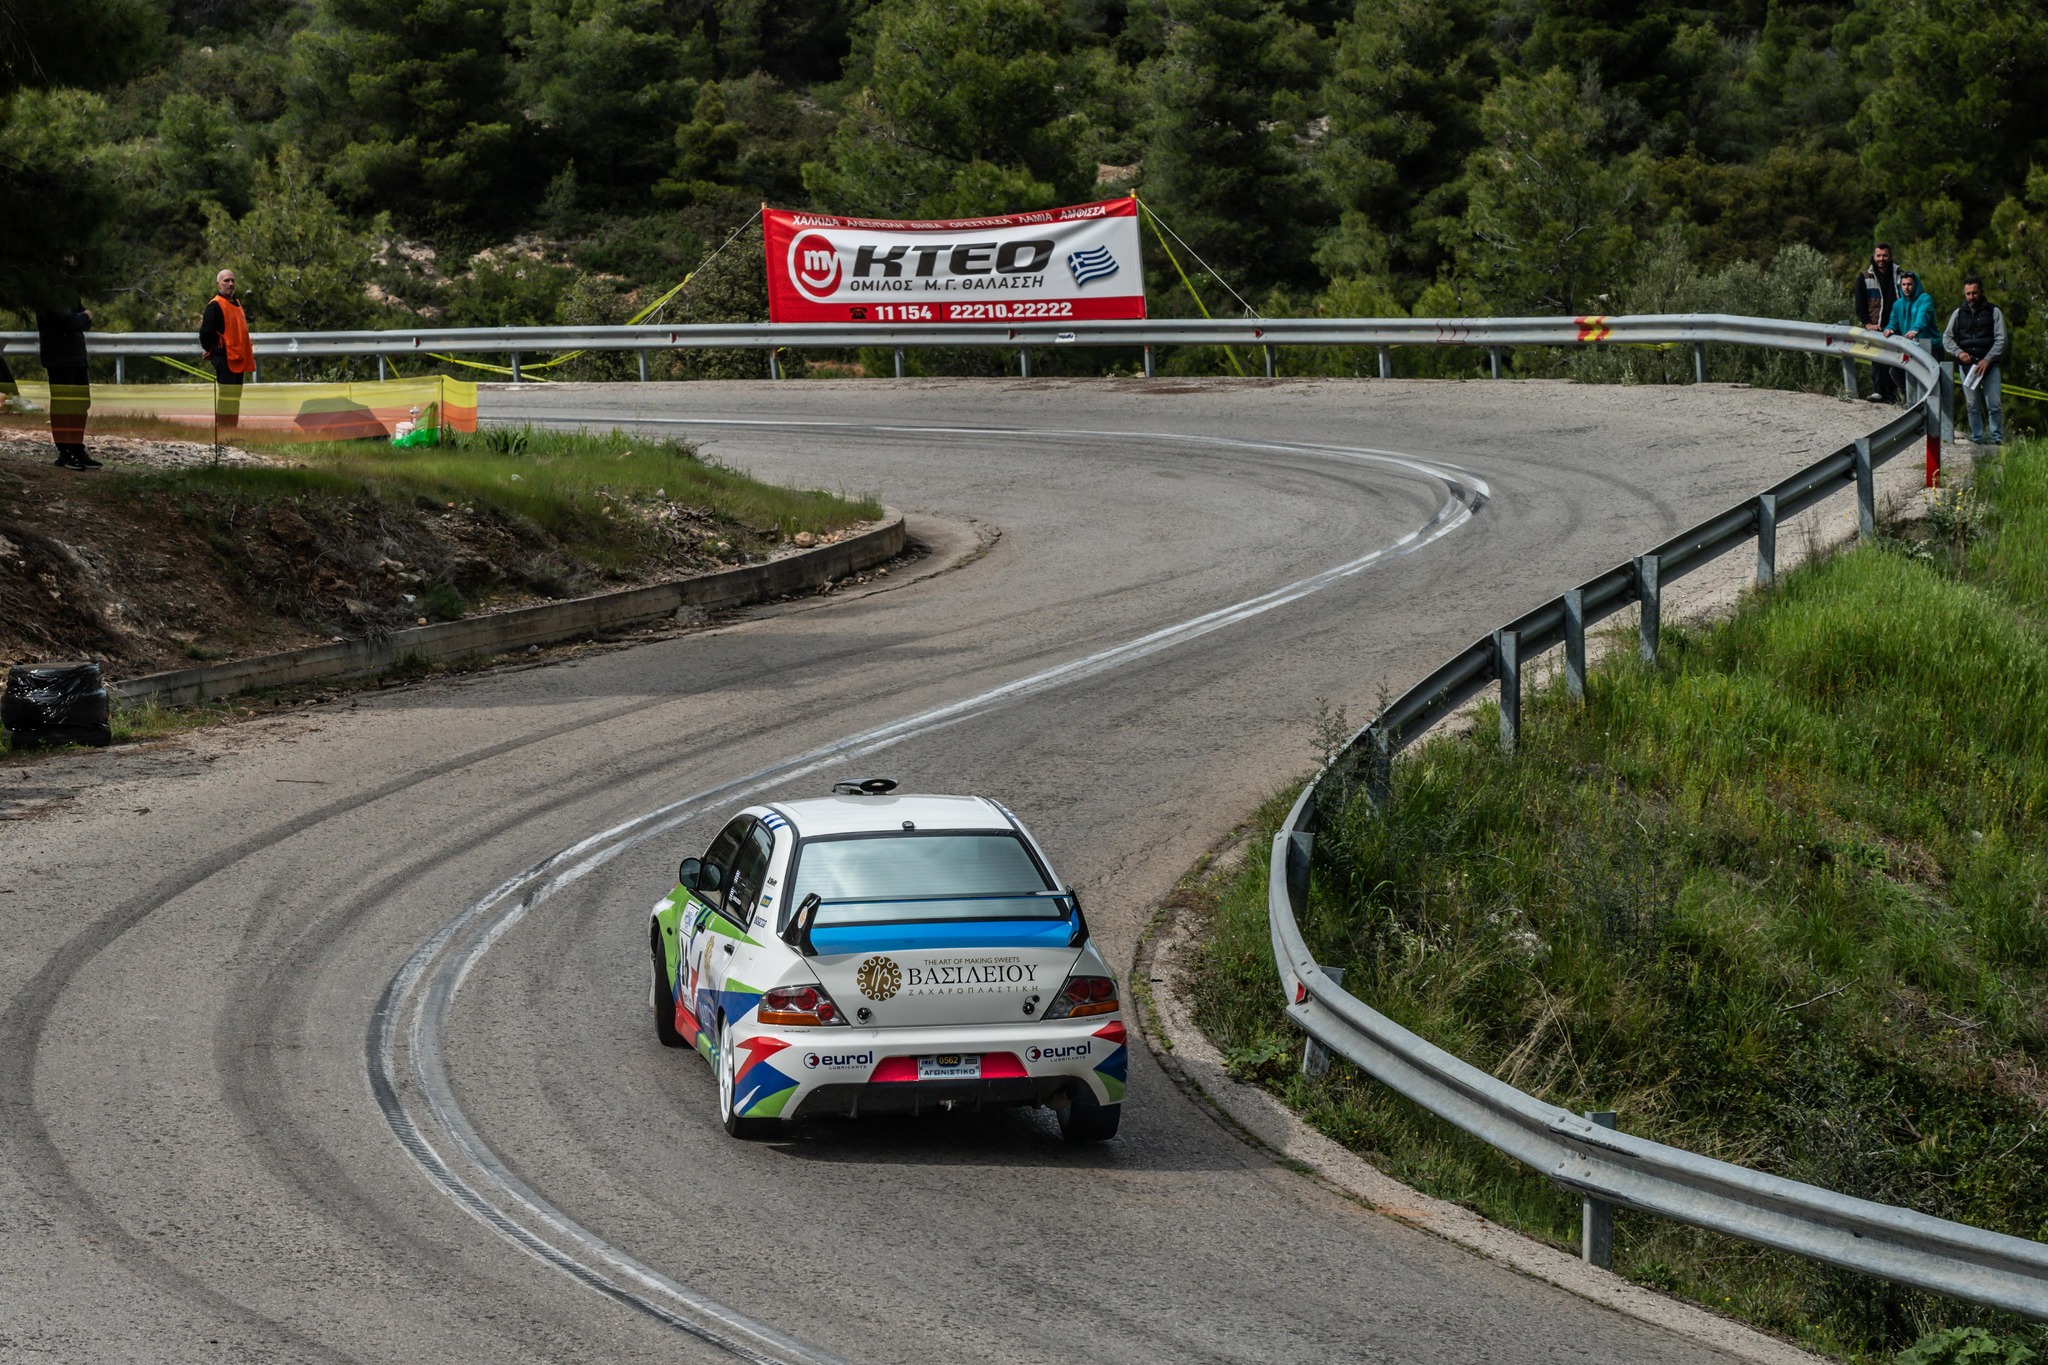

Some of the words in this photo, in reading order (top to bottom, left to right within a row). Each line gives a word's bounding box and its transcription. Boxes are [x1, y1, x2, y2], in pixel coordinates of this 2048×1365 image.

[792, 215, 840, 227] ΧΑΛΚΙΔΑ
[1018, 212, 1053, 224] ΛΑΜΙΑ
[1059, 206, 1107, 220] ΑΜΦΙΣΣΑ
[852, 239, 1056, 278] ΚΤΕΟ
[802, 250, 841, 286] my
[850, 279, 913, 292] ΟΜΙΛΟΣ
[962, 275, 1044, 290] ΘΑΛΑΣΣΗ
[875, 305, 894, 320] 11
[898, 305, 932, 320] 154
[950, 302, 1073, 319] 22210.22222
[938, 958, 951, 966] ART
[964, 957, 993, 965] MAKING
[994, 956, 1020, 964] SWEETS
[907, 964, 1038, 986] ΒΑΣΙΛΕΙΟΥ
[908, 985, 1038, 996] ΖΑΧΑΡΟΠΛΑΣΤΙΚΗ
[821, 1050, 873, 1066] eurol
[1043, 1041, 1091, 1058] eurol
[938, 1056, 959, 1065] 0562
[924, 1068, 976, 1076] ΑΓΩΝΙΣΤΙΚΟ
